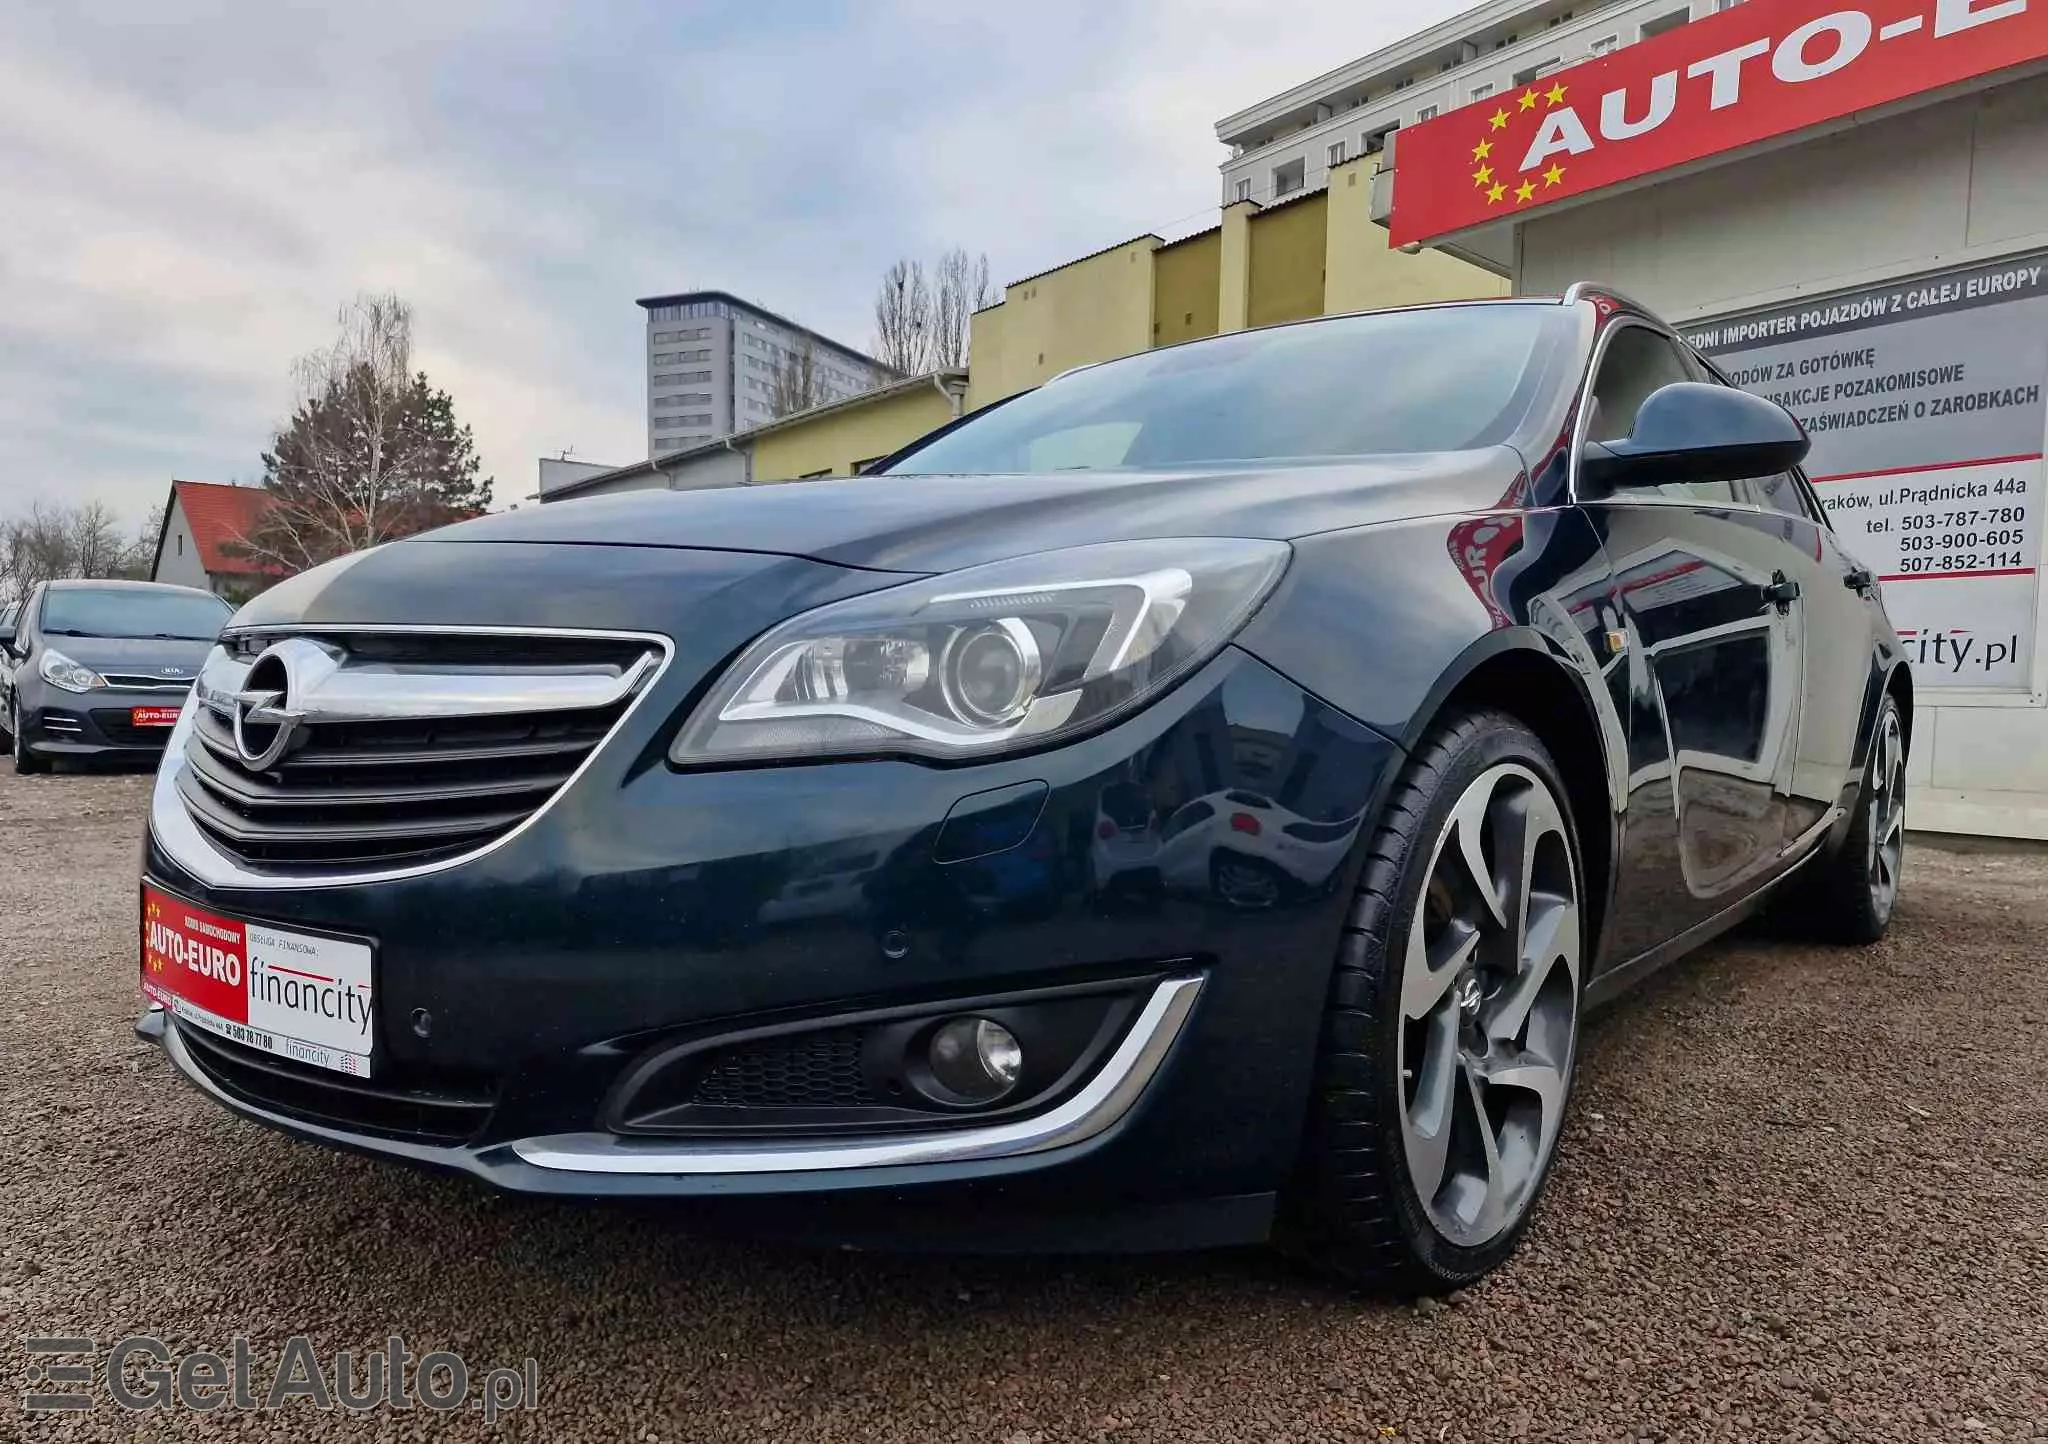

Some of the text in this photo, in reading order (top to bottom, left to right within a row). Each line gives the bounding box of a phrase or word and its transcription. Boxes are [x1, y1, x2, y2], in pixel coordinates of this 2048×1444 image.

[1686, 266, 2042, 348] EDNI IMPORTER POJAZDÓW Z CAŁEJ EUROPY
[1727, 348, 1875, 386] ODÓW ZA GOTÓWKĘ
[1834, 363, 1965, 400] POZAKOMISOWE
[1799, 385, 2040, 433] ZAŚWIADCZEŃ O ZAROBKACH
[1821, 492, 1873, 509] raków,
[1993, 478, 2027, 496] 44a
[1866, 507, 2026, 533] tel. 503-787-780
[1900, 529, 2025, 551] 503-900-605
[1900, 551, 2022, 572] 507-852-114
[1902, 628, 2018, 673] ity.pl
[150, 920, 241, 987] AUTO-EURO
[250, 956, 373, 1035] financity
